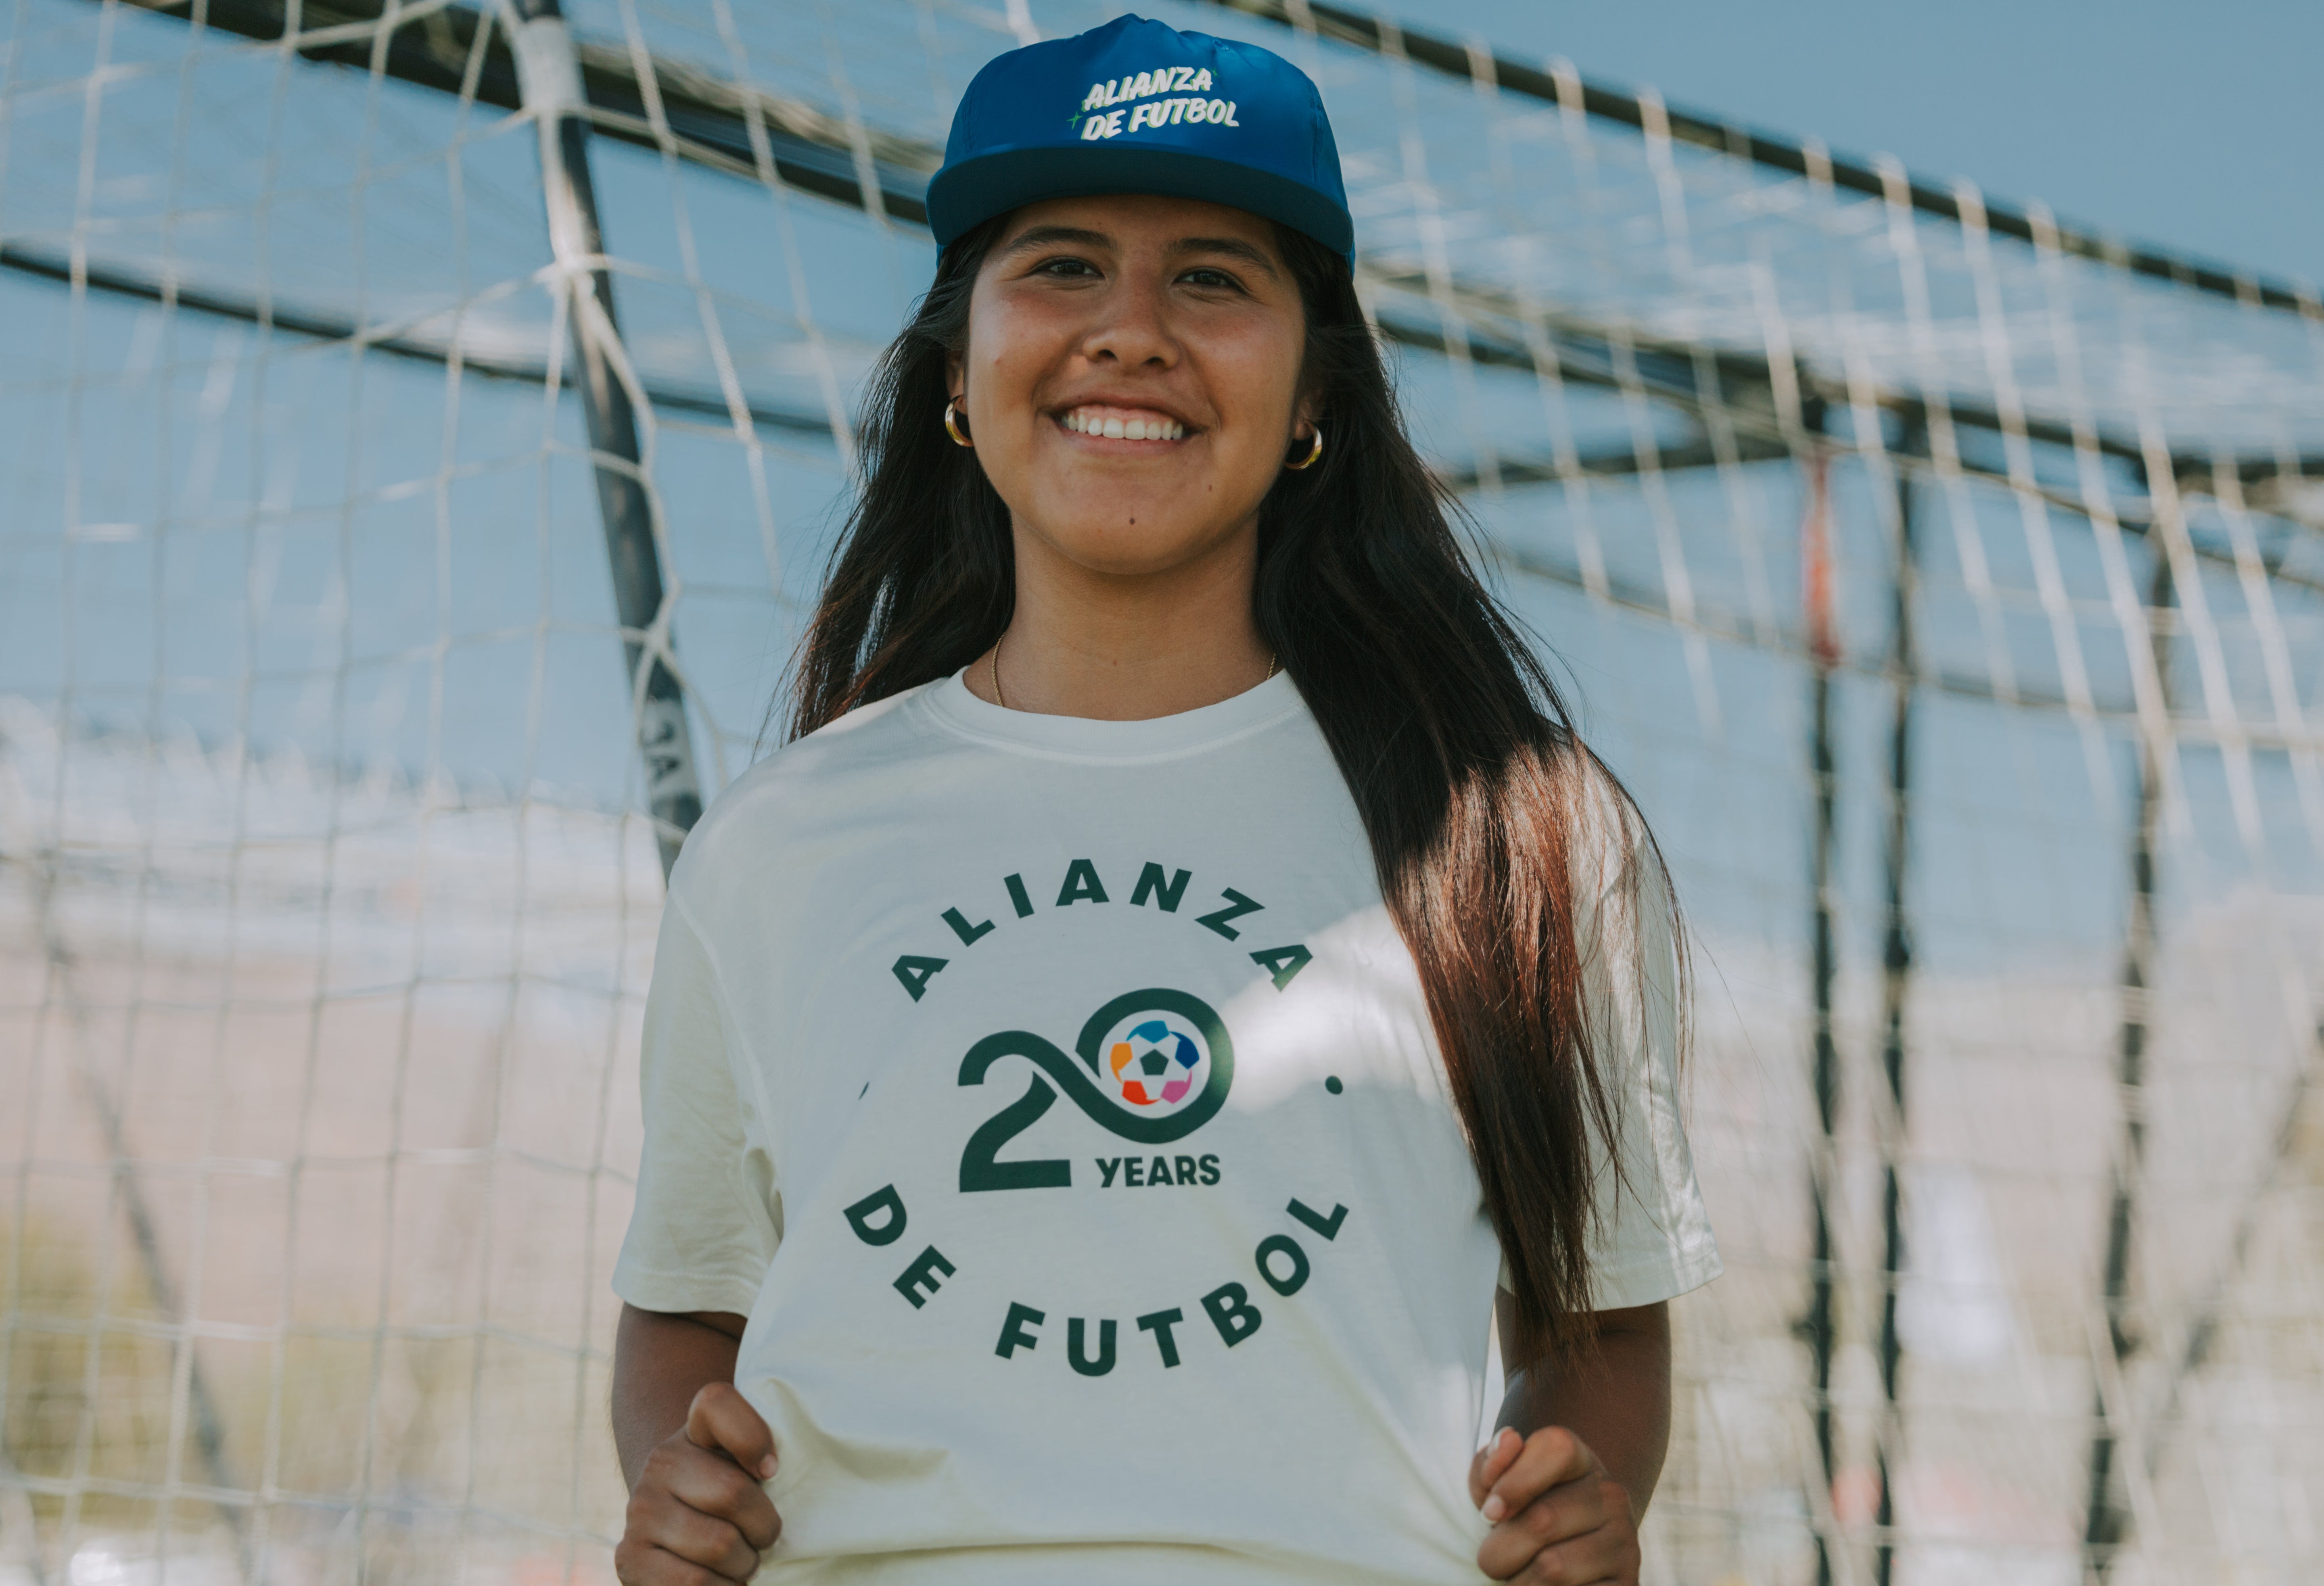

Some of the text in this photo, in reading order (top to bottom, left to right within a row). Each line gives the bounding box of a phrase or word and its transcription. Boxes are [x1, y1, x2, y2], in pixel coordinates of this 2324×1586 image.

[1081, 98, 1239, 140] DE FUTBOL
[1082, 67, 1212, 112] ALIANZA
[892, 859, 1313, 1003] ALIANZA
[958, 988, 1234, 1192] 20
[1095, 1154, 1221, 1188] YEARS
[843, 1183, 1349, 1377] DE FUTBOL
